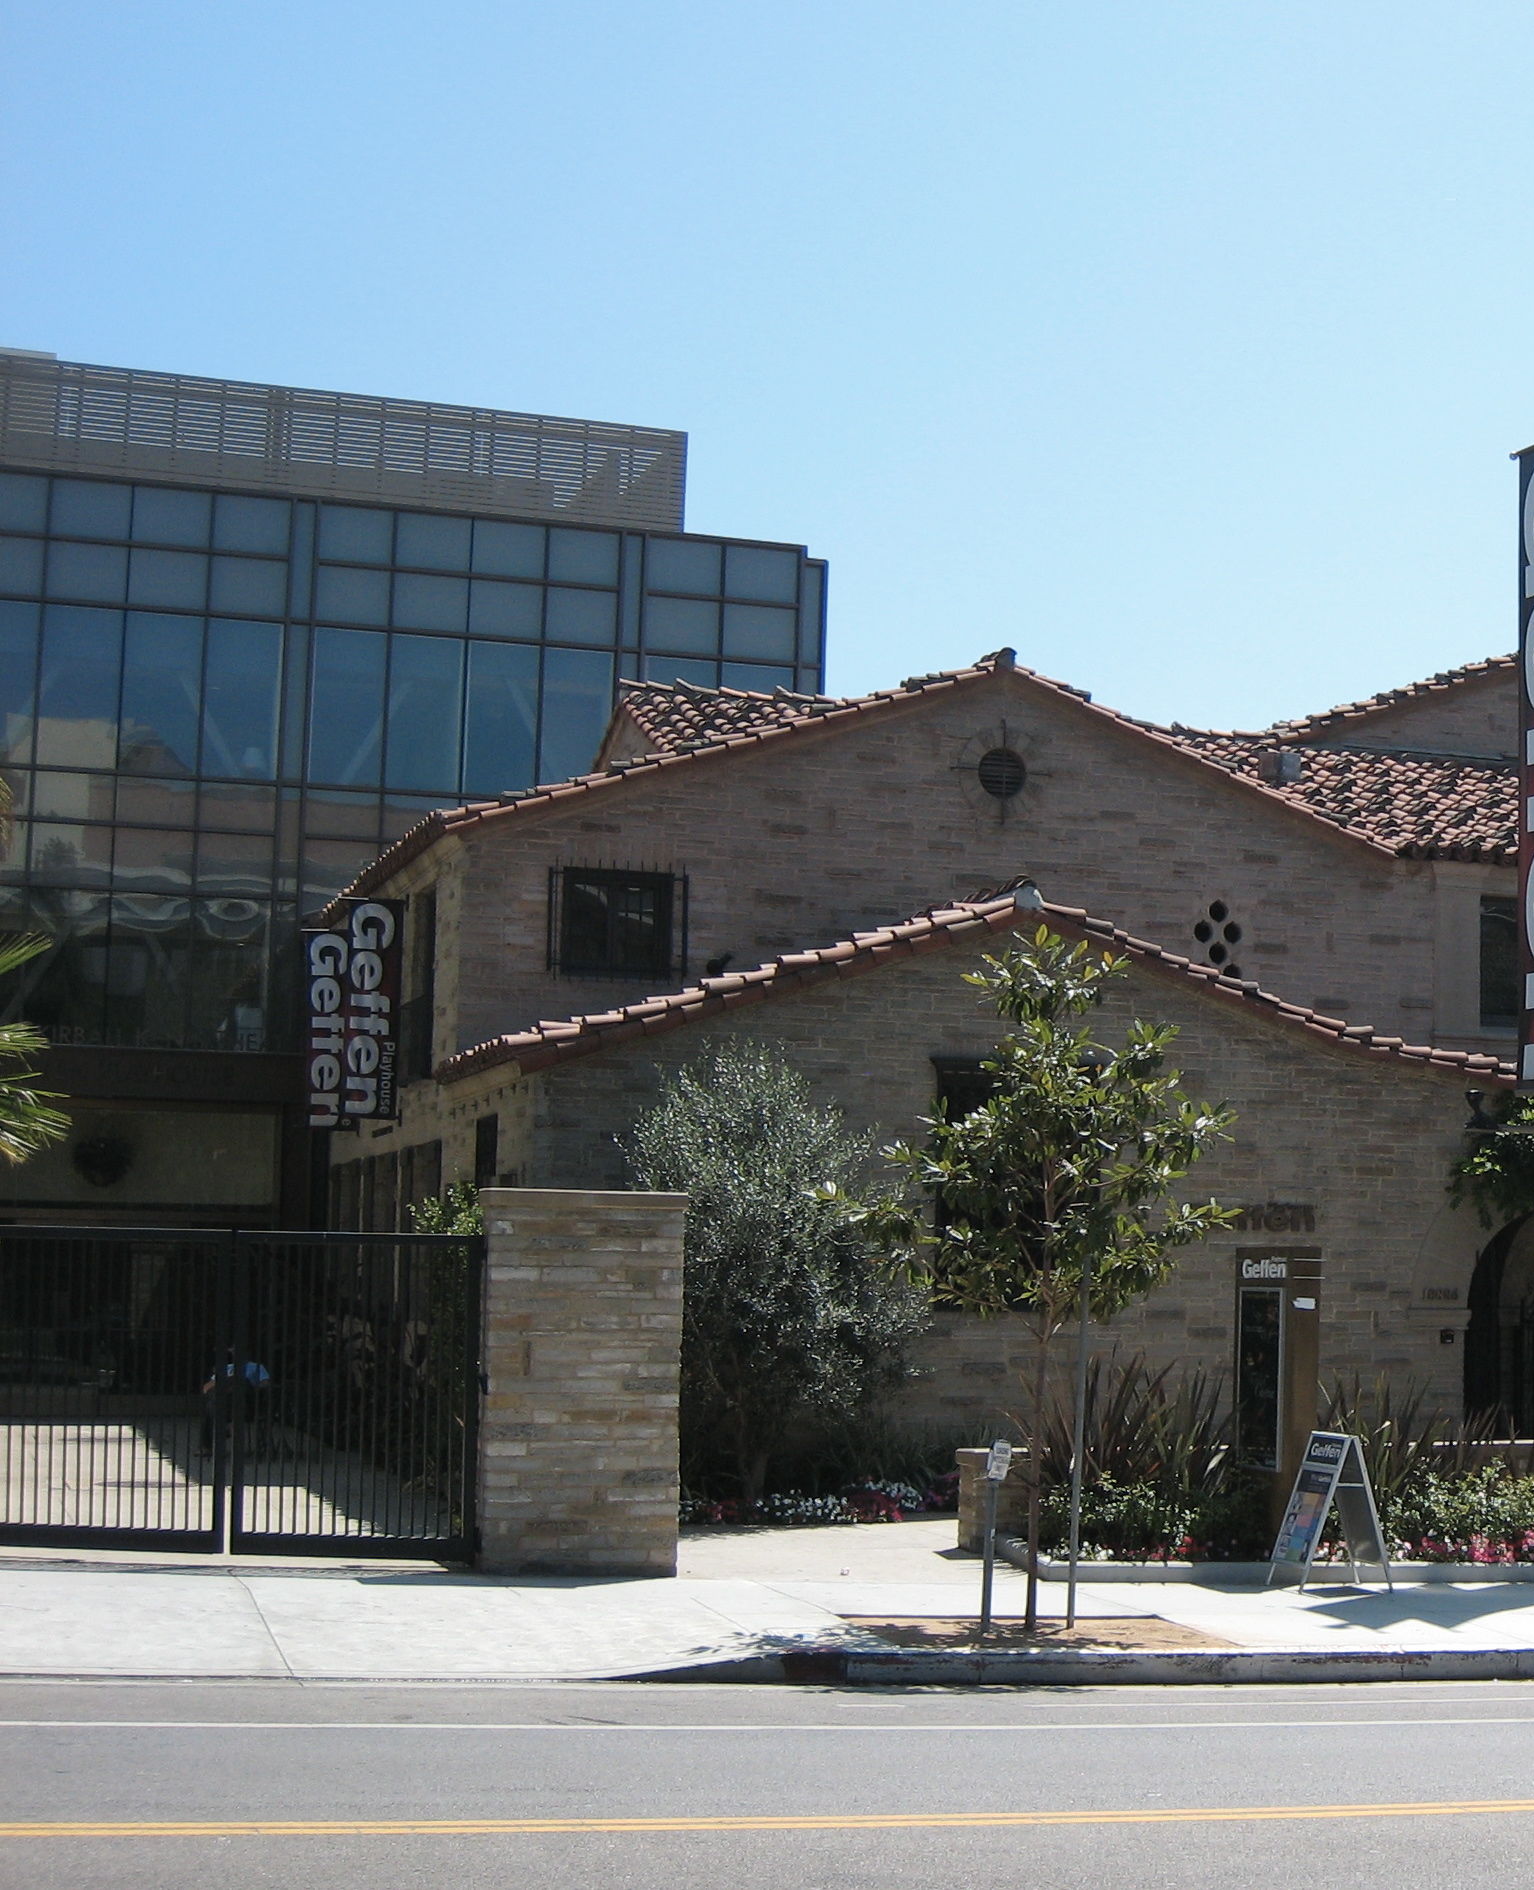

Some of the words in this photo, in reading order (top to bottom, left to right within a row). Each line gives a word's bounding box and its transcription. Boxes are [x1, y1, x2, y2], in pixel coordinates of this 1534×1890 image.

[309, 933, 349, 1127] Geffen
[345, 903, 396, 1115] Geffen
[379, 1041, 396, 1115] Playhouse
[1242, 1258, 1287, 1279] Geffen
[1310, 1442, 1342, 1459] Geffen
